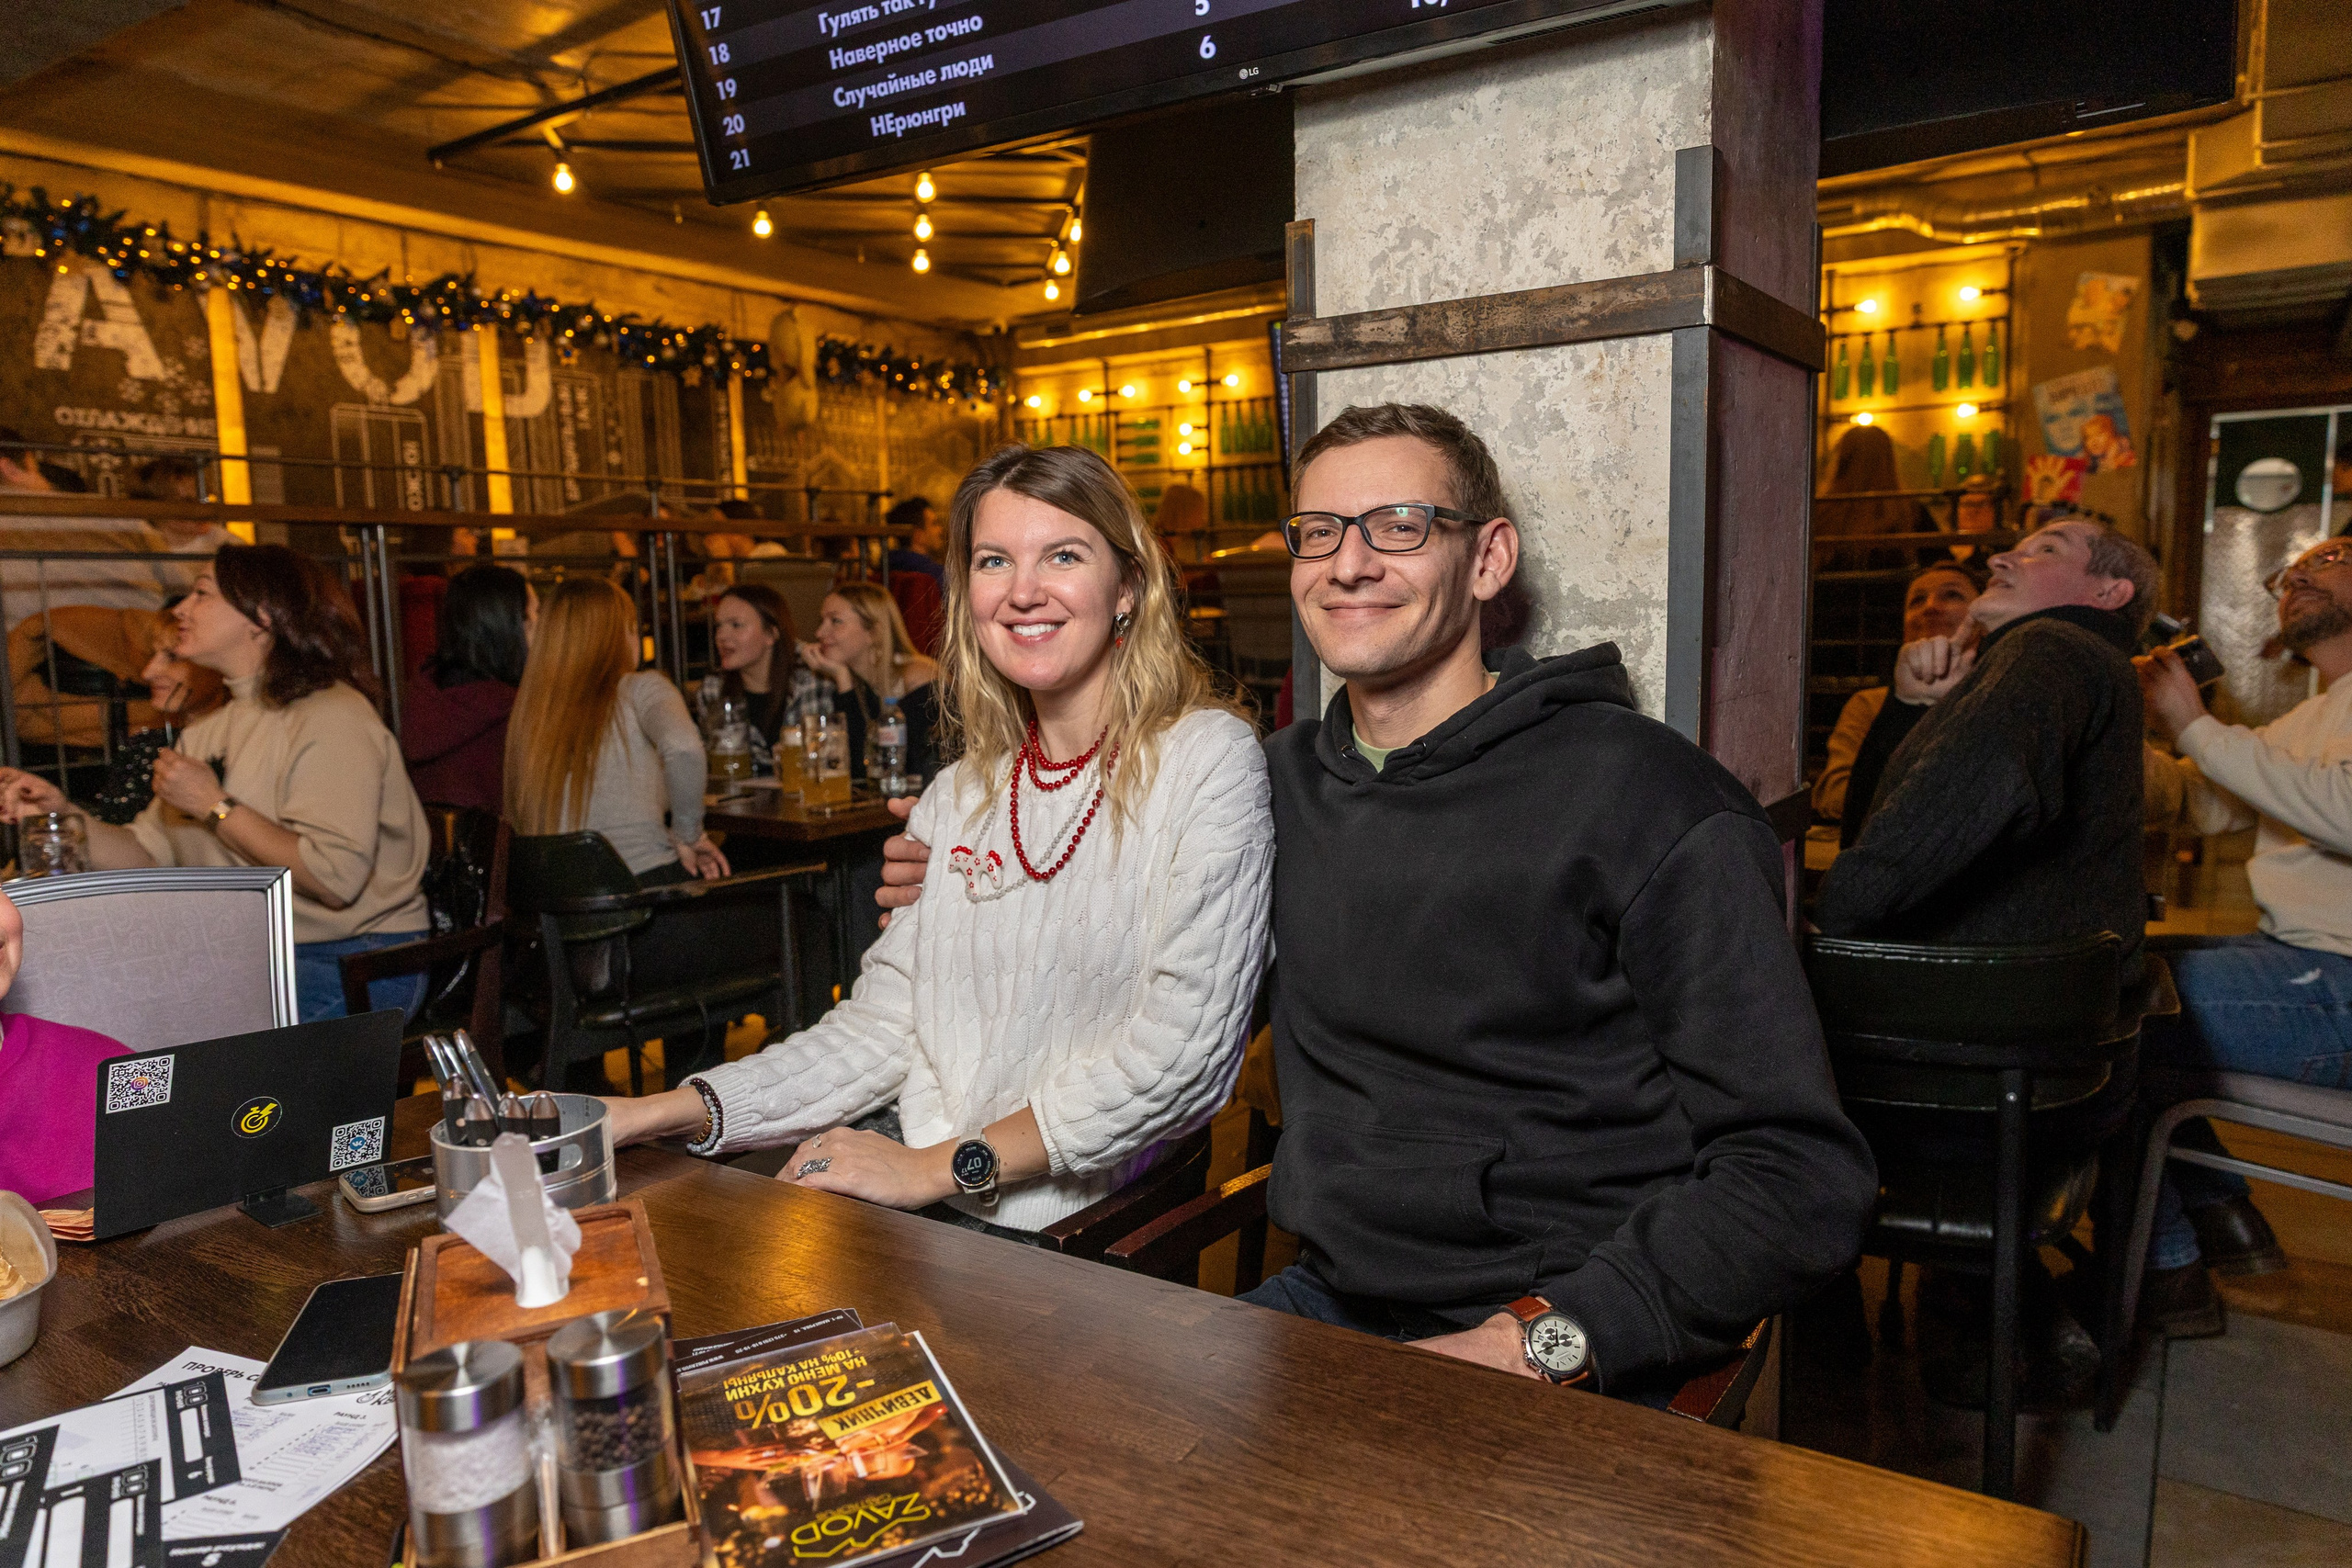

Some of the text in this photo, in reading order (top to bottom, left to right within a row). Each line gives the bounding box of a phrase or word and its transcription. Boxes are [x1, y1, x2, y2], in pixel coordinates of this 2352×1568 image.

[701, 7, 722, 30] 17
[819, 5, 879, 37] Гулять
[708, 43, 730, 65] 18
[830, 16, 983, 70] Наверное точно
[1199, 35, 1216, 59] 6
[833, 53, 994, 108] Случайные люди
[1249, 67, 1260, 76] LG
[717, 78, 737, 100] 19
[722, 114, 744, 136] 20
[870, 101, 966, 137] НЕрюнгри
[730, 149, 751, 170] 21
[723, 1348, 860, 1390] -10% НА КАЛЬЯНЫ
[725, 1356, 868, 1402] НА МЕНЮ КУХНИ
[735, 1374, 876, 1429] -20%
[837, 1385, 933, 1432] ДЕВИЧНИК
[791, 1492, 931, 1545] ZAVOD
